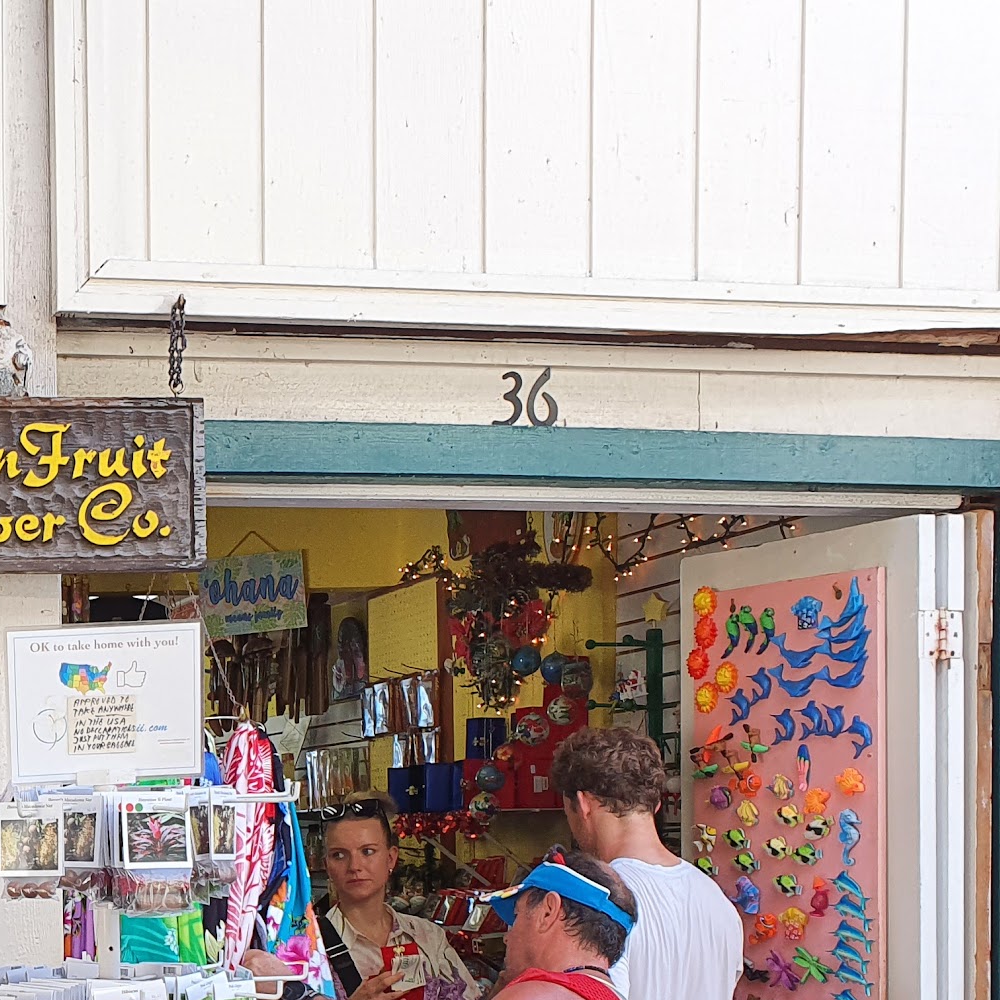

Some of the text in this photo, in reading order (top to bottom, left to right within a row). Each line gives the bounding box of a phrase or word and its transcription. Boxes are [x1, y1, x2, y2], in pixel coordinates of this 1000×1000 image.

[492, 366, 558, 426] 36
[19, 422, 172, 488] Fruit
[78, 483, 172, 545] Co.
[30, 636, 179, 652] OK to take home with you!
[73, 696, 116, 707] APPROVED
[73, 707, 95, 717] TAKE
[75, 717, 126, 728] IN THE USA
